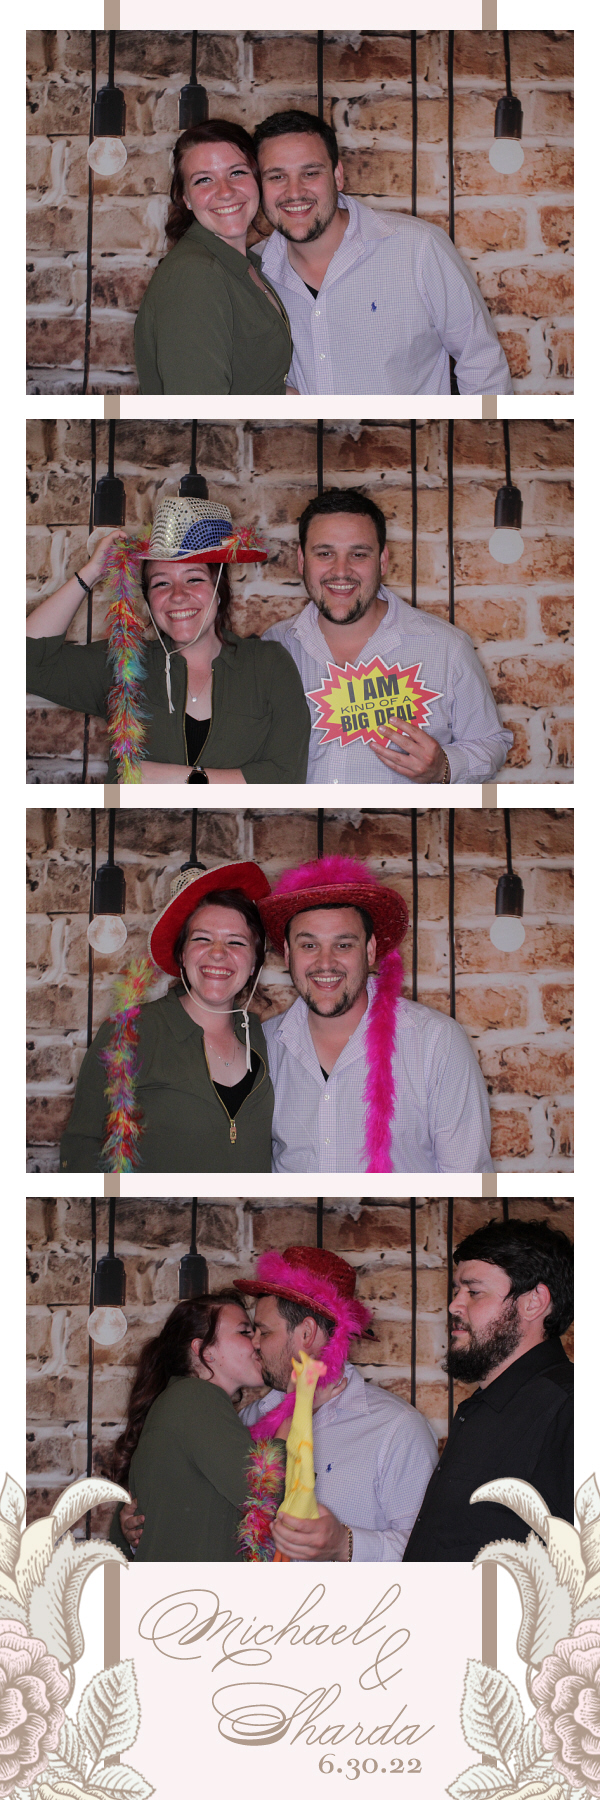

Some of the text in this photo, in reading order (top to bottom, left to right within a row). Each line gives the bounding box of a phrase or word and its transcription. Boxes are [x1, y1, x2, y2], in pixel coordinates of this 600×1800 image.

[347, 674, 400, 703] I AM
[340, 704, 417, 733] BIG DEAL
[341, 695, 412, 714] KIND OF A
